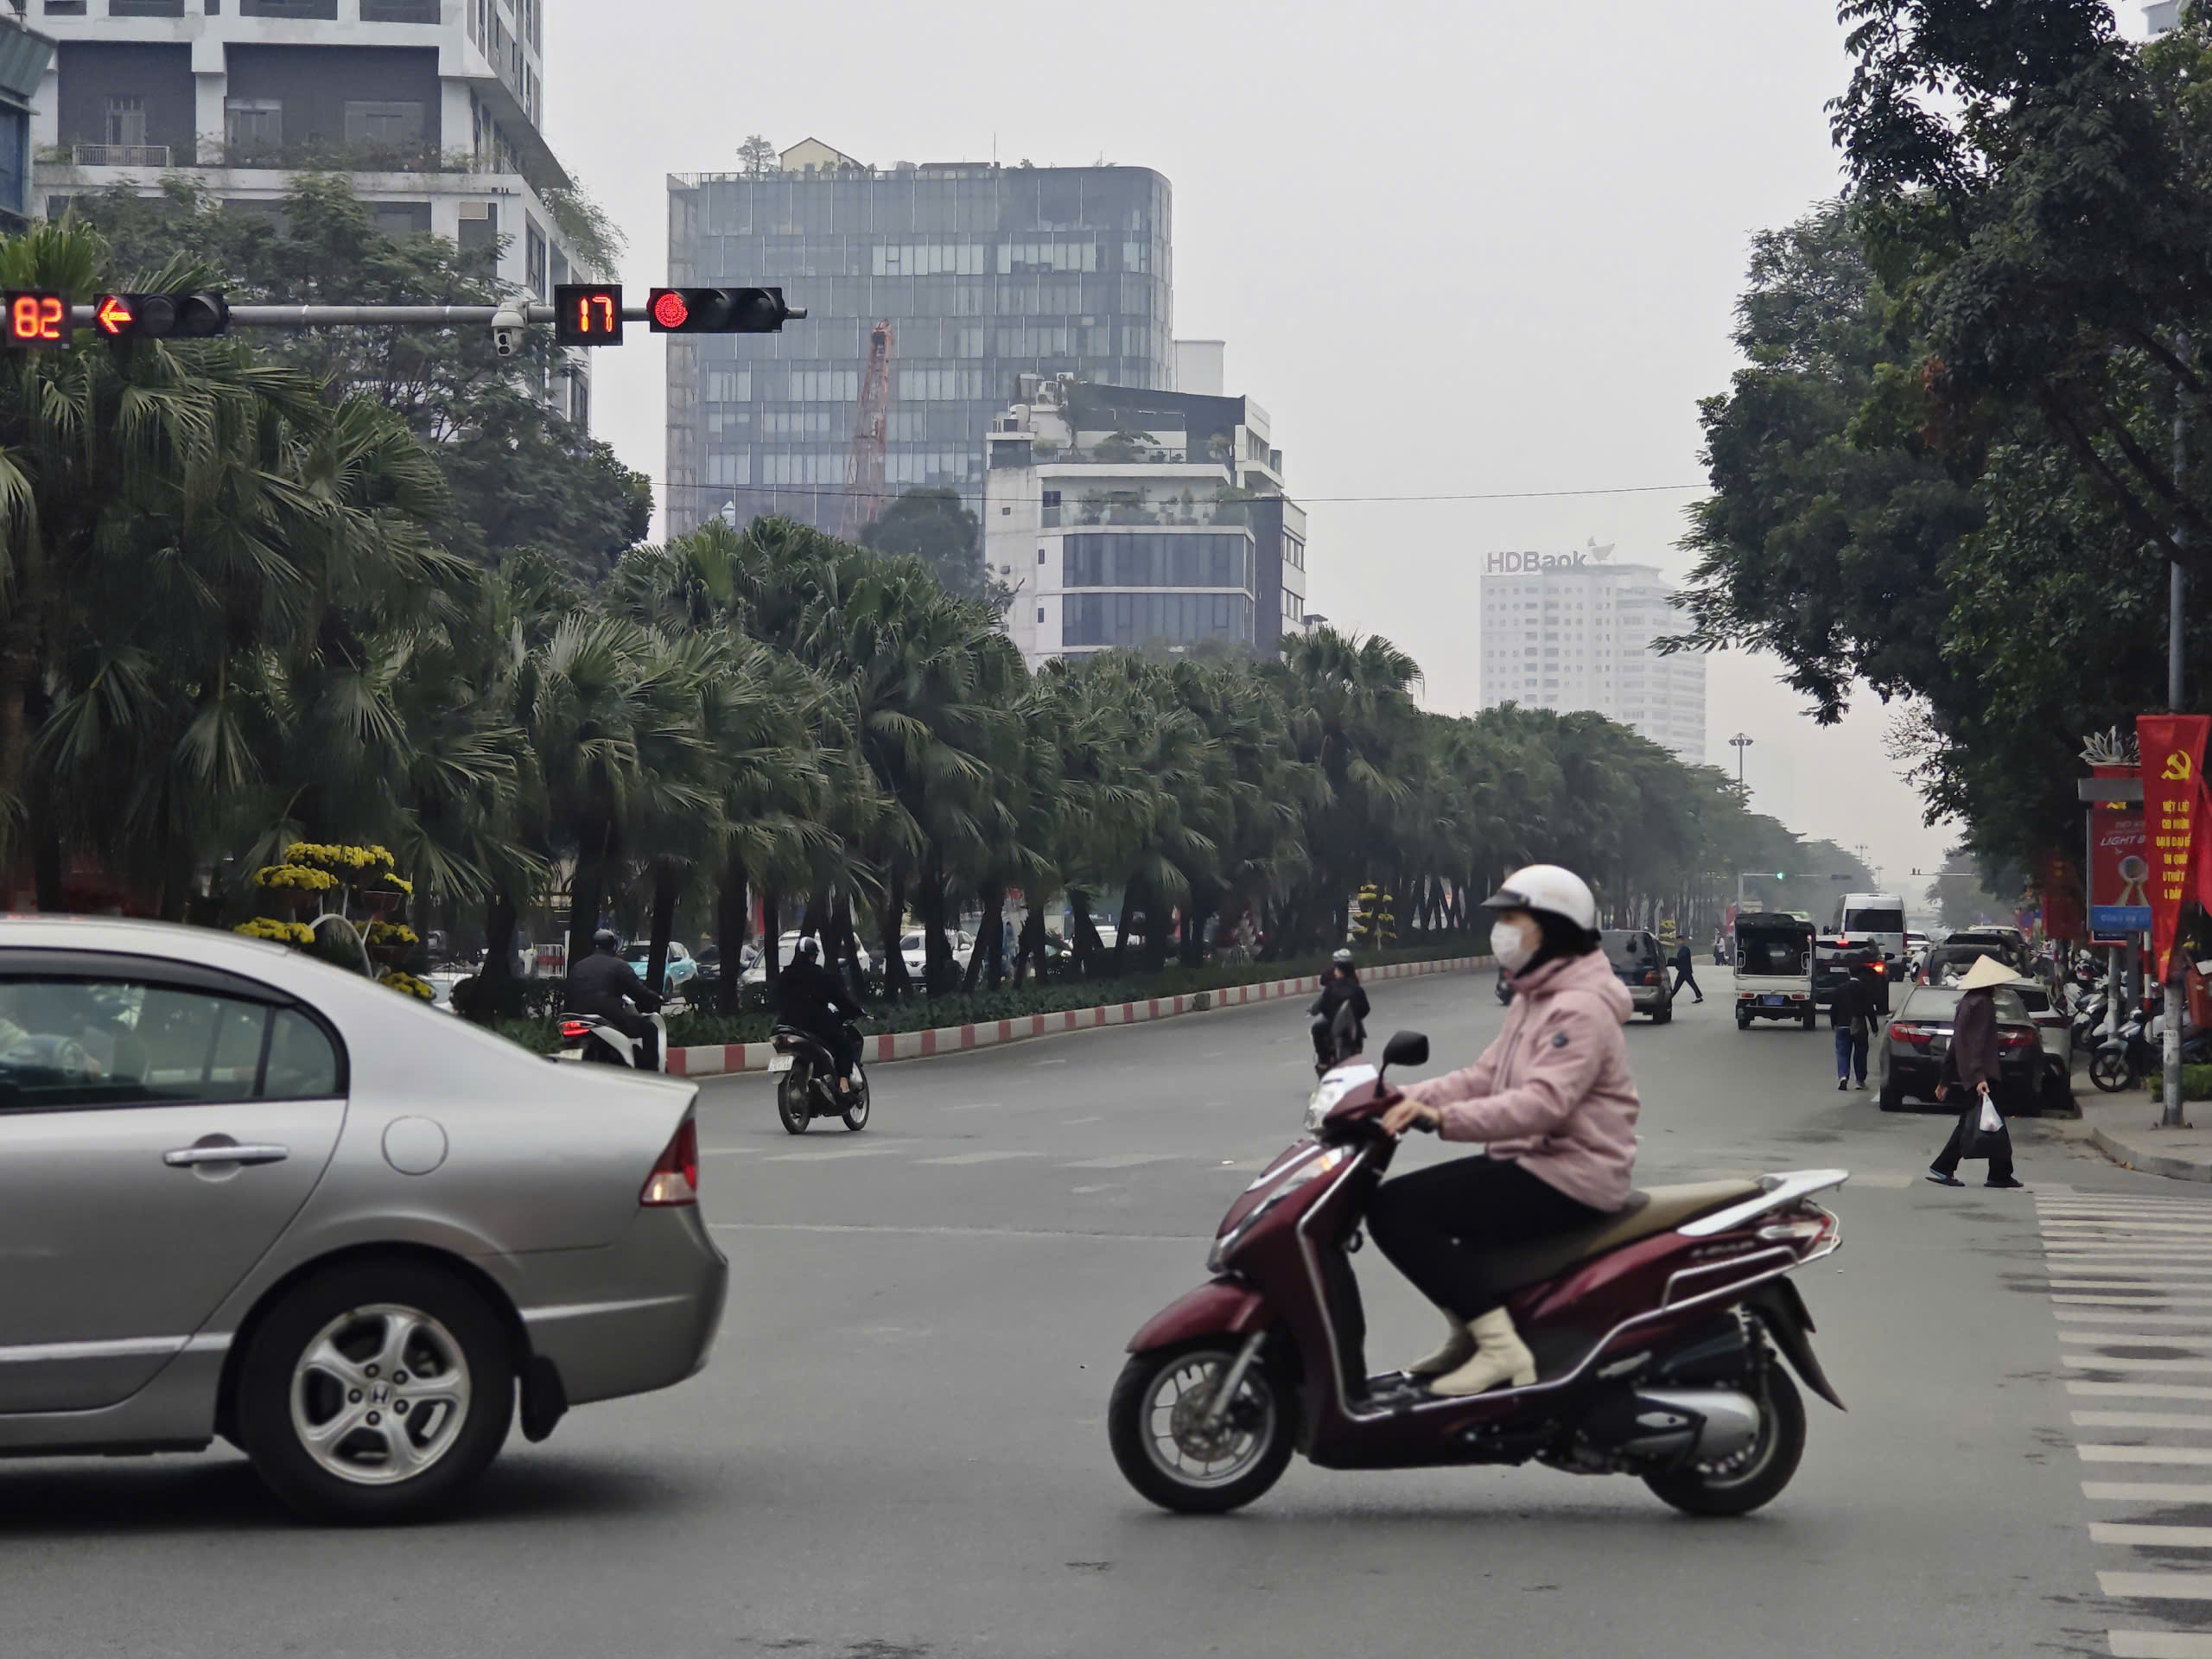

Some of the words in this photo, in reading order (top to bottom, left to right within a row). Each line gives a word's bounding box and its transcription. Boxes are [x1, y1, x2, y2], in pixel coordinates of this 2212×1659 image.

[14, 296, 62, 338] 82
[580, 296, 613, 333] 17
[1487, 550, 1586, 573] HDBank
[2101, 836, 2137, 846] LIGHT
